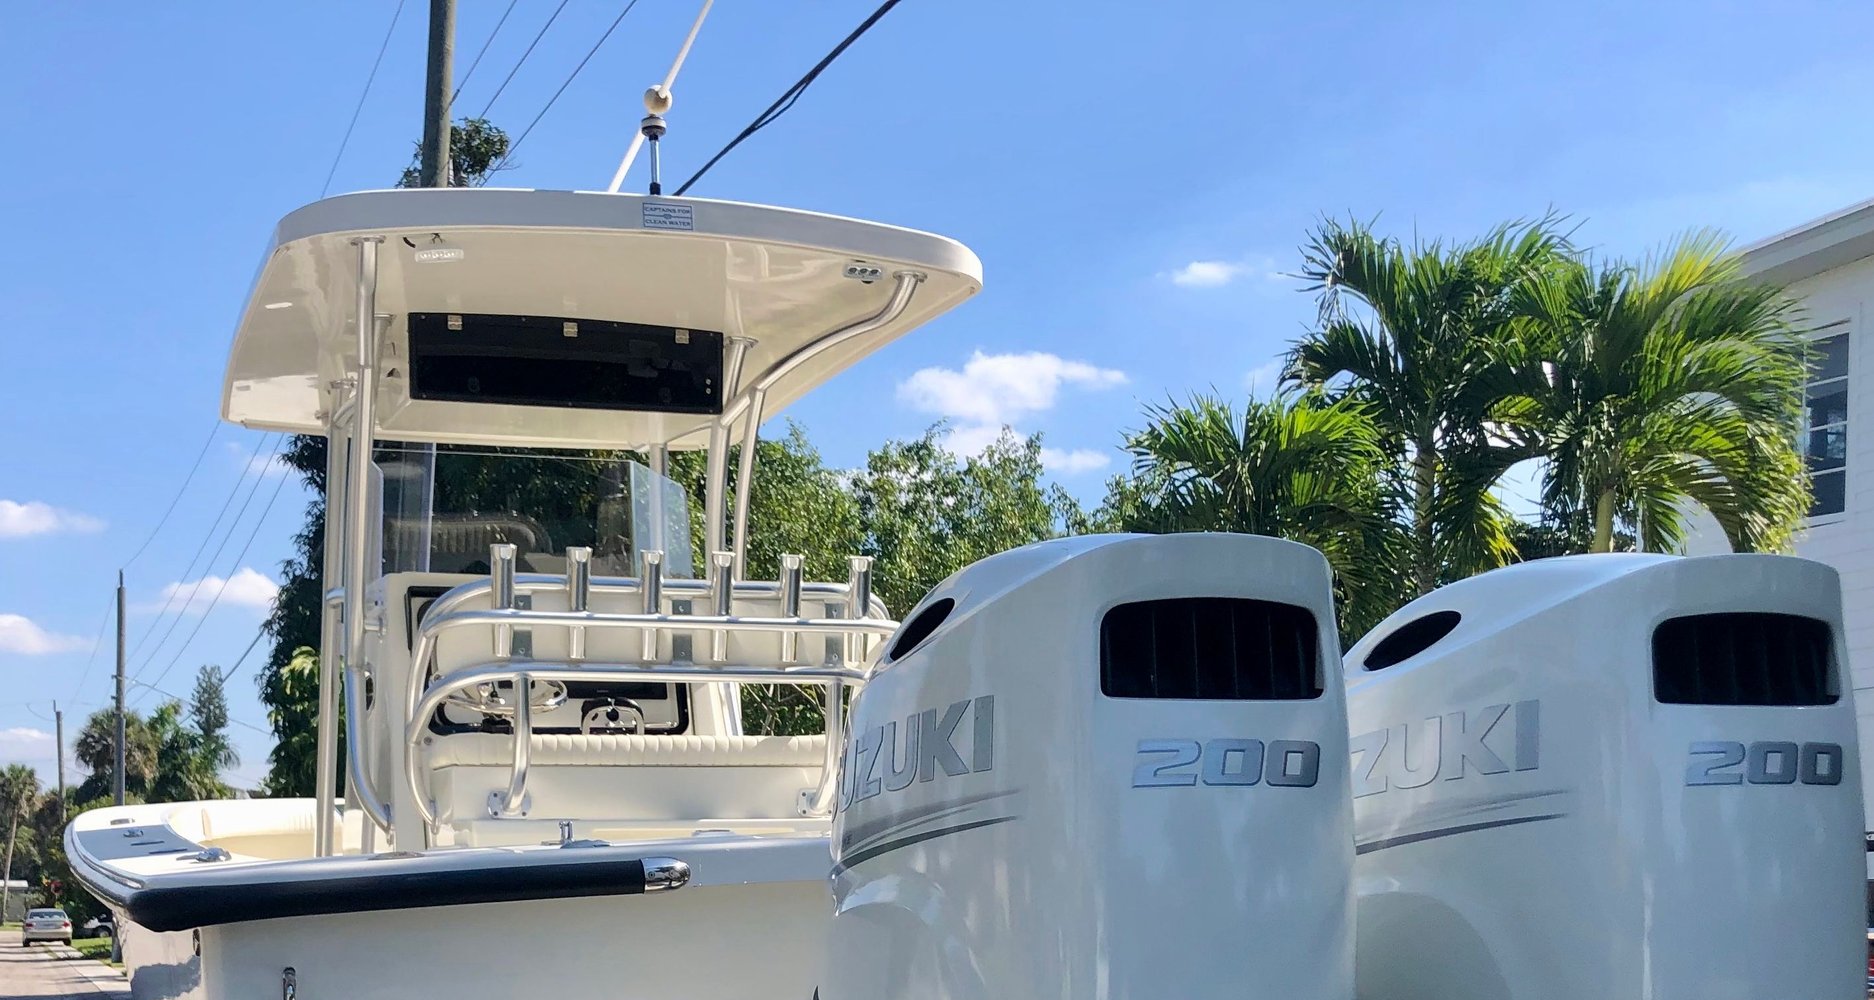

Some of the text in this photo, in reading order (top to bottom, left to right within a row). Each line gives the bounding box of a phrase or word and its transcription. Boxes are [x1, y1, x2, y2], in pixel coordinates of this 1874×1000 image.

[644, 206, 676, 214] CAPTAINS
[1132, 738, 1321, 788] 200
[1685, 741, 1843, 787] 200
